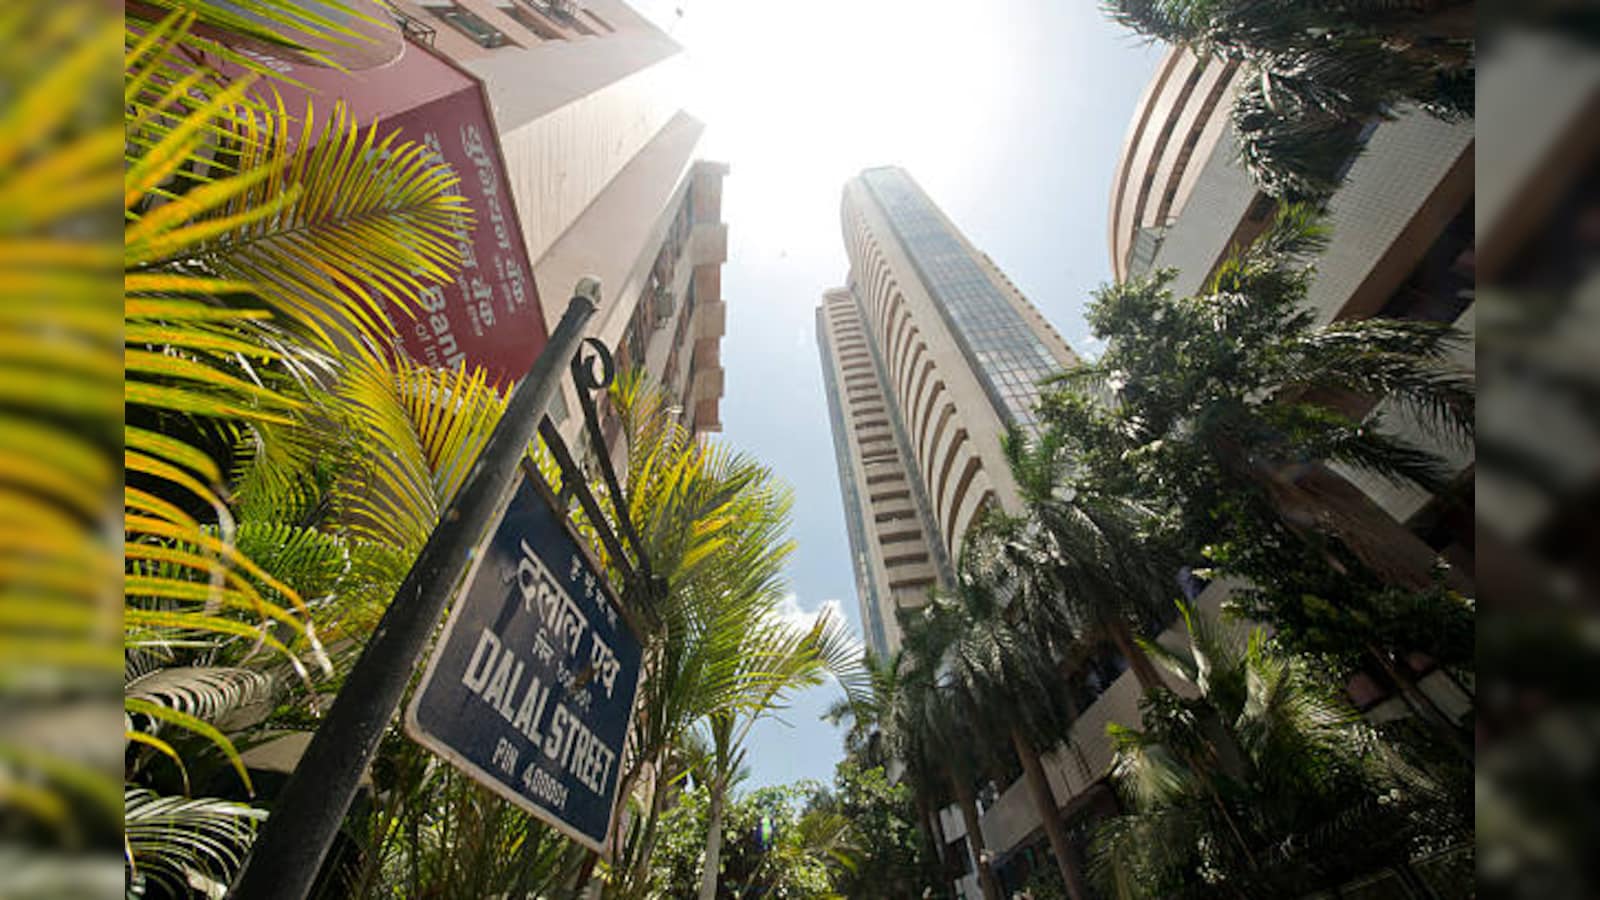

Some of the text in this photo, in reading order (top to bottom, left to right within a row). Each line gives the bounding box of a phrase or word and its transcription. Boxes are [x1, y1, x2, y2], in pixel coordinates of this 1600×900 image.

[518, 538, 588, 658] दलाल
[590, 631, 621, 700] पथ
[461, 627, 615, 796] DALAL STREET
[492, 737, 519, 777] PIN
